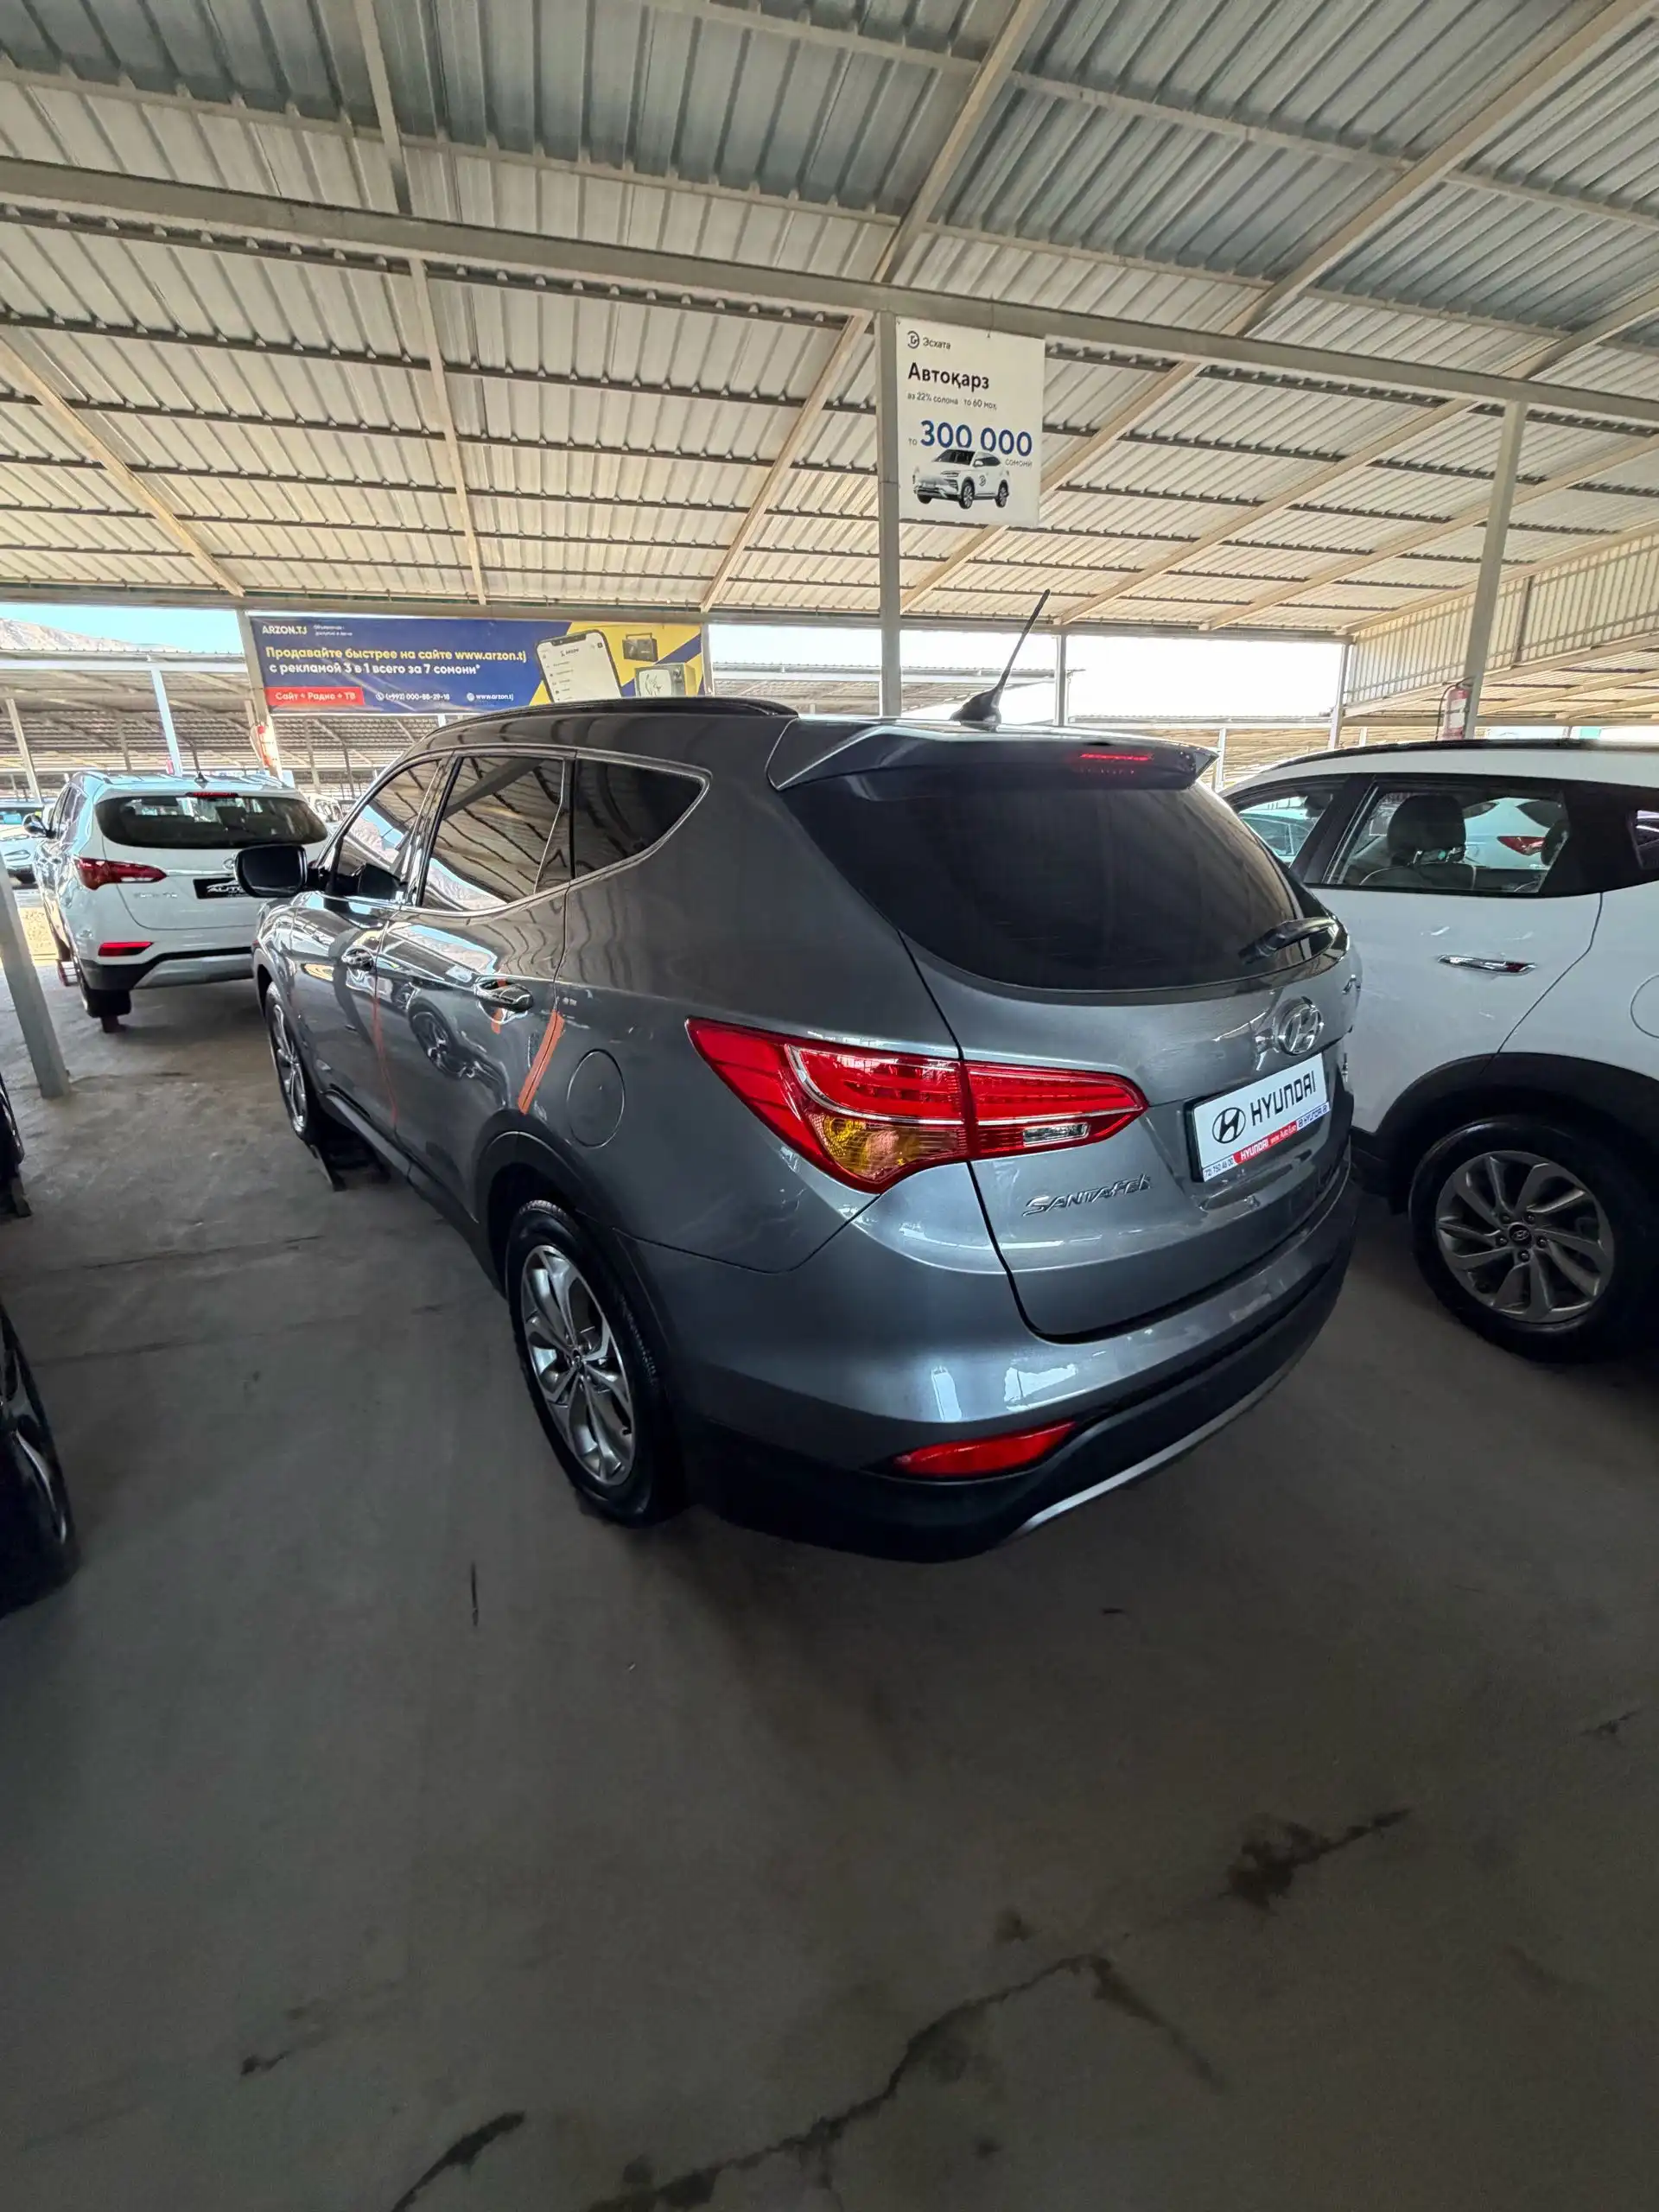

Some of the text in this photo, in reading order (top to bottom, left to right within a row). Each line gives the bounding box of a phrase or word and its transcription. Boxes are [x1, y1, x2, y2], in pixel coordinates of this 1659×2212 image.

[922, 337, 951, 350] Эсхата
[907, 361, 990, 392] Автоқарз
[916, 391, 932, 402] 22%
[973, 398, 983, 409] 60
[920, 420, 973, 449] 300
[980, 427, 1033, 457] 000
[262, 625, 308, 635] ARZON.TJ
[265, 646, 527, 664] Продавайте быстрее на сайте www.arzon.tj
[269, 664, 277, 673] с
[279, 663, 342, 676] рекламой
[343, 662, 353, 673] 3
[354, 664, 363, 673] в
[364, 663, 371, 673] 1
[372, 664, 406, 674] всего
[408, 665, 423, 674] за
[423, 664, 431, 674] 7
[275, 691, 299, 701] Сайт
[308, 692, 335, 702] Радио
[476, 693, 514, 702] www.arzon.tj
[1249, 1071, 1317, 1127] HYUNDAI
[1240, 1139, 1269, 1160] HYUNDAI
